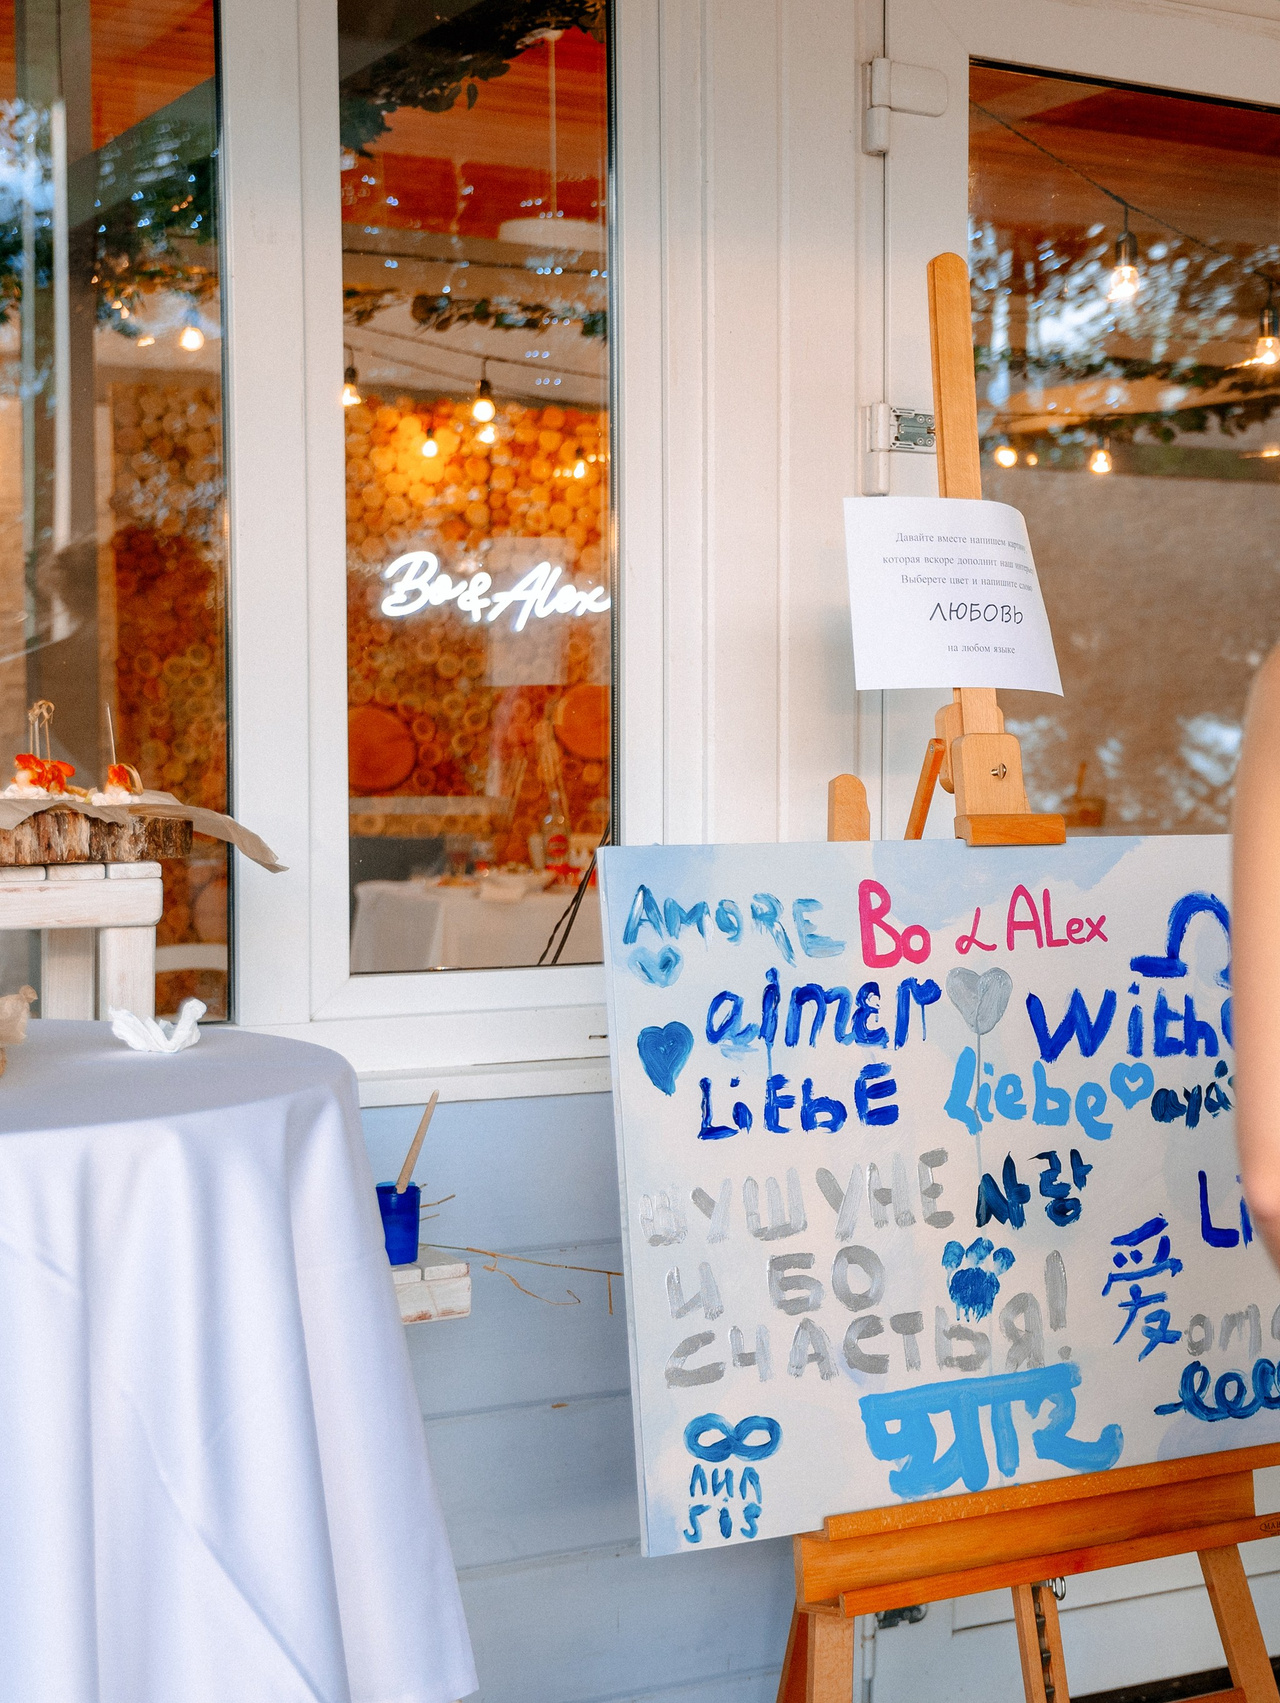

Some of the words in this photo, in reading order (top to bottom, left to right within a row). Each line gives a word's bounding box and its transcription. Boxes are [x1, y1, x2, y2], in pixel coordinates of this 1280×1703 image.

[895, 532, 934, 543] Давайте
[937, 534, 967, 545] вместе
[969, 536, 1006, 547] напишем
[882, 555, 921, 566] которая
[924, 555, 955, 567] вскоре
[956, 556, 998, 567] дополнит
[999, 560, 1014, 569] наш
[901, 573, 947, 586] Выберете
[949, 576, 969, 586] цвет
[972, 577, 978, 586] и
[981, 578, 1018, 589] напишите
[929, 602, 1024, 625] ЛЮБОВЬ
[947, 644, 959, 653] на
[961, 643, 991, 654] любом
[993, 645, 1016, 655] языке
[623, 884, 847, 968] AMORE
[858, 879, 931, 968] Bo
[975, 1148, 1093, 1230] 사랑
[665, 1261, 724, 1321] И
[767, 1245, 886, 1316] БО
